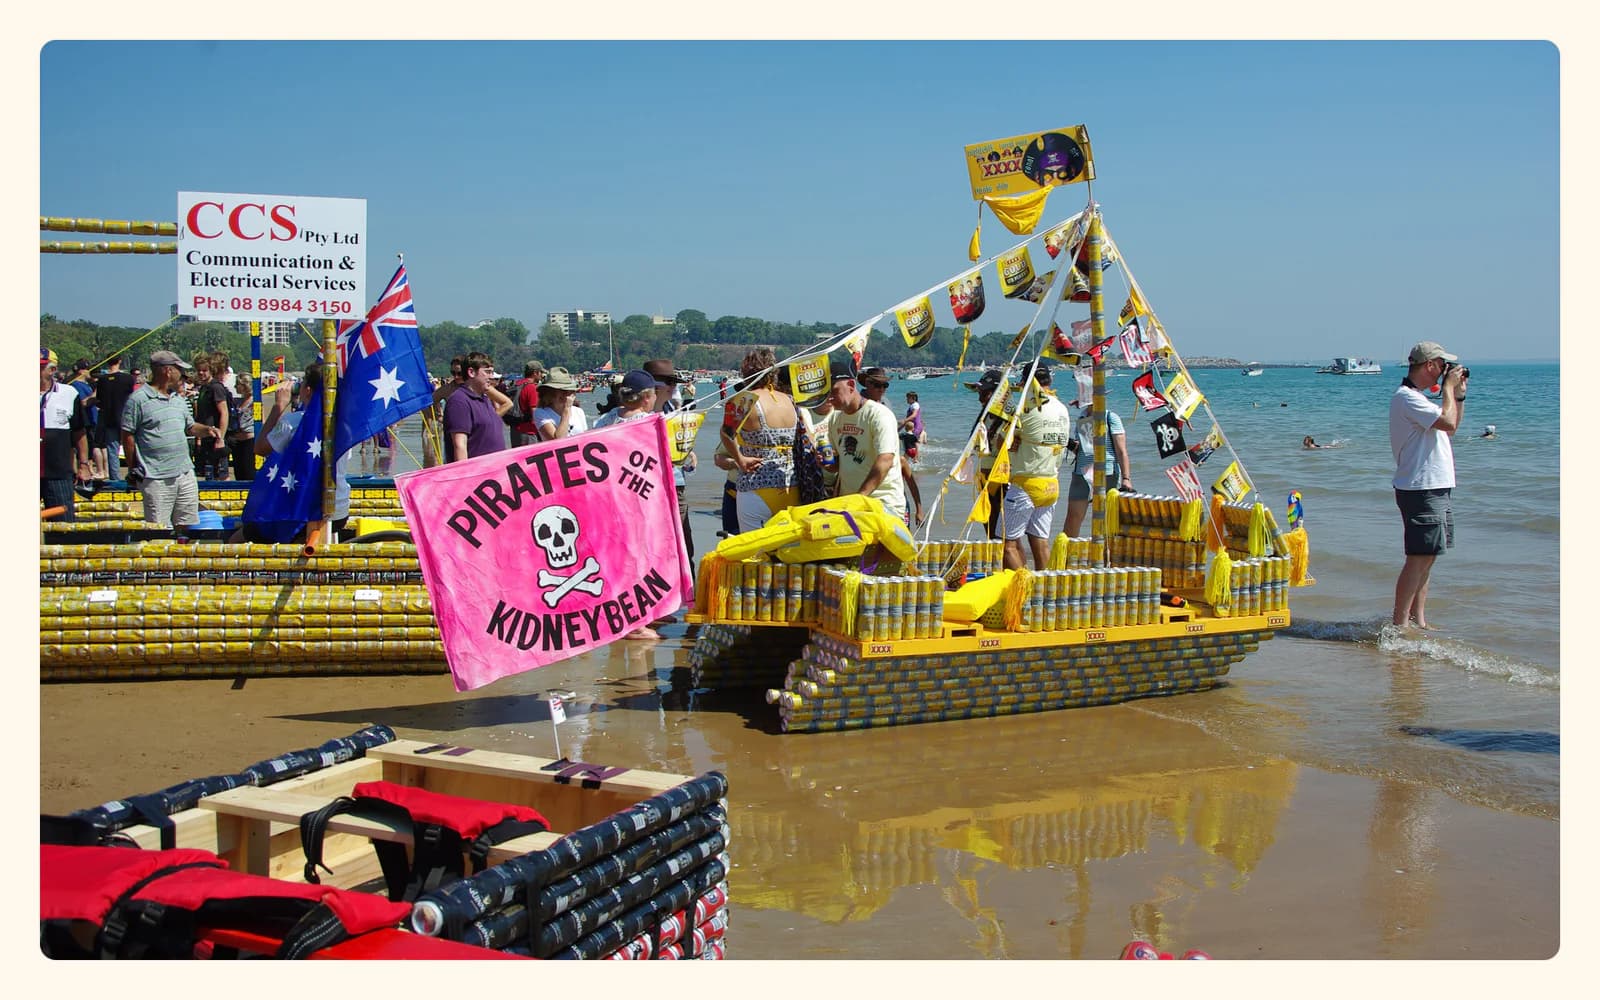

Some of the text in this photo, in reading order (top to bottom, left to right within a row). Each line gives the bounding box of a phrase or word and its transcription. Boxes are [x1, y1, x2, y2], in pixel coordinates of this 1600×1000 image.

[187, 201, 359, 247] CCS Pty Ltd
[186, 250, 356, 271] Communication &
[190, 272, 357, 291] Electrical Services
[193, 295, 352, 314] Ph: 08 8984 3150
[797, 368, 825, 382] GOLD
[628, 450, 658, 473] OF
[617, 466, 654, 500] THE
[447, 442, 610, 549] PIRATES
[871, 645, 892, 654] XXXX
[980, 640, 1000, 648] XXXX
